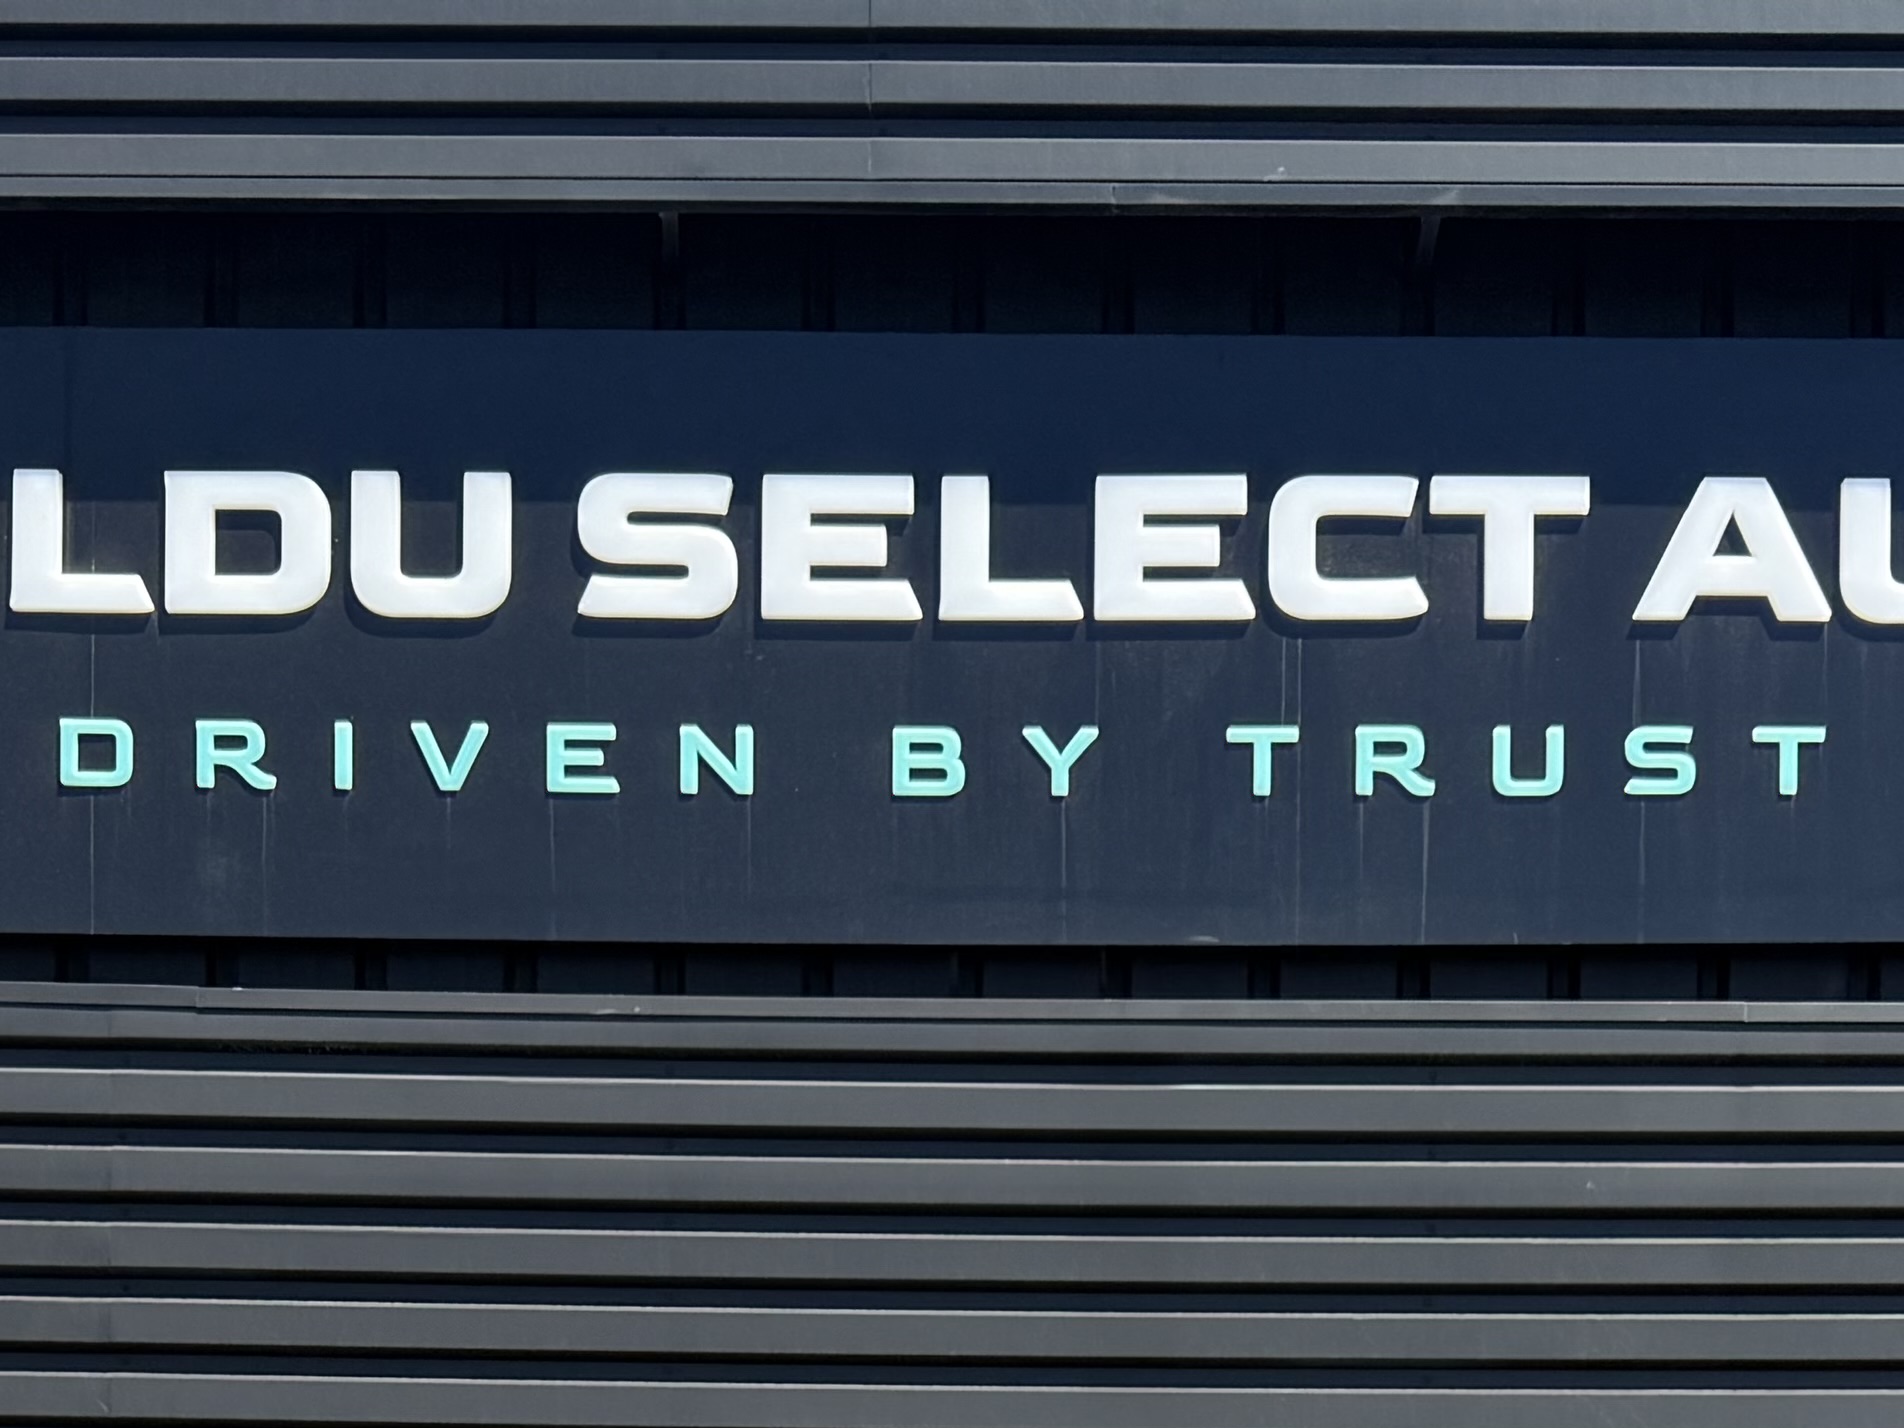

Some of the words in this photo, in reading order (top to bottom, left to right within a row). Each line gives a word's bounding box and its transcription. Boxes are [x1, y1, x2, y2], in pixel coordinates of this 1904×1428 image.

[577, 473, 1591, 621] SELECT
[58, 717, 754, 796] DRIVEN
[891, 725, 1100, 797] BY
[1225, 725, 1827, 797] TRUST
